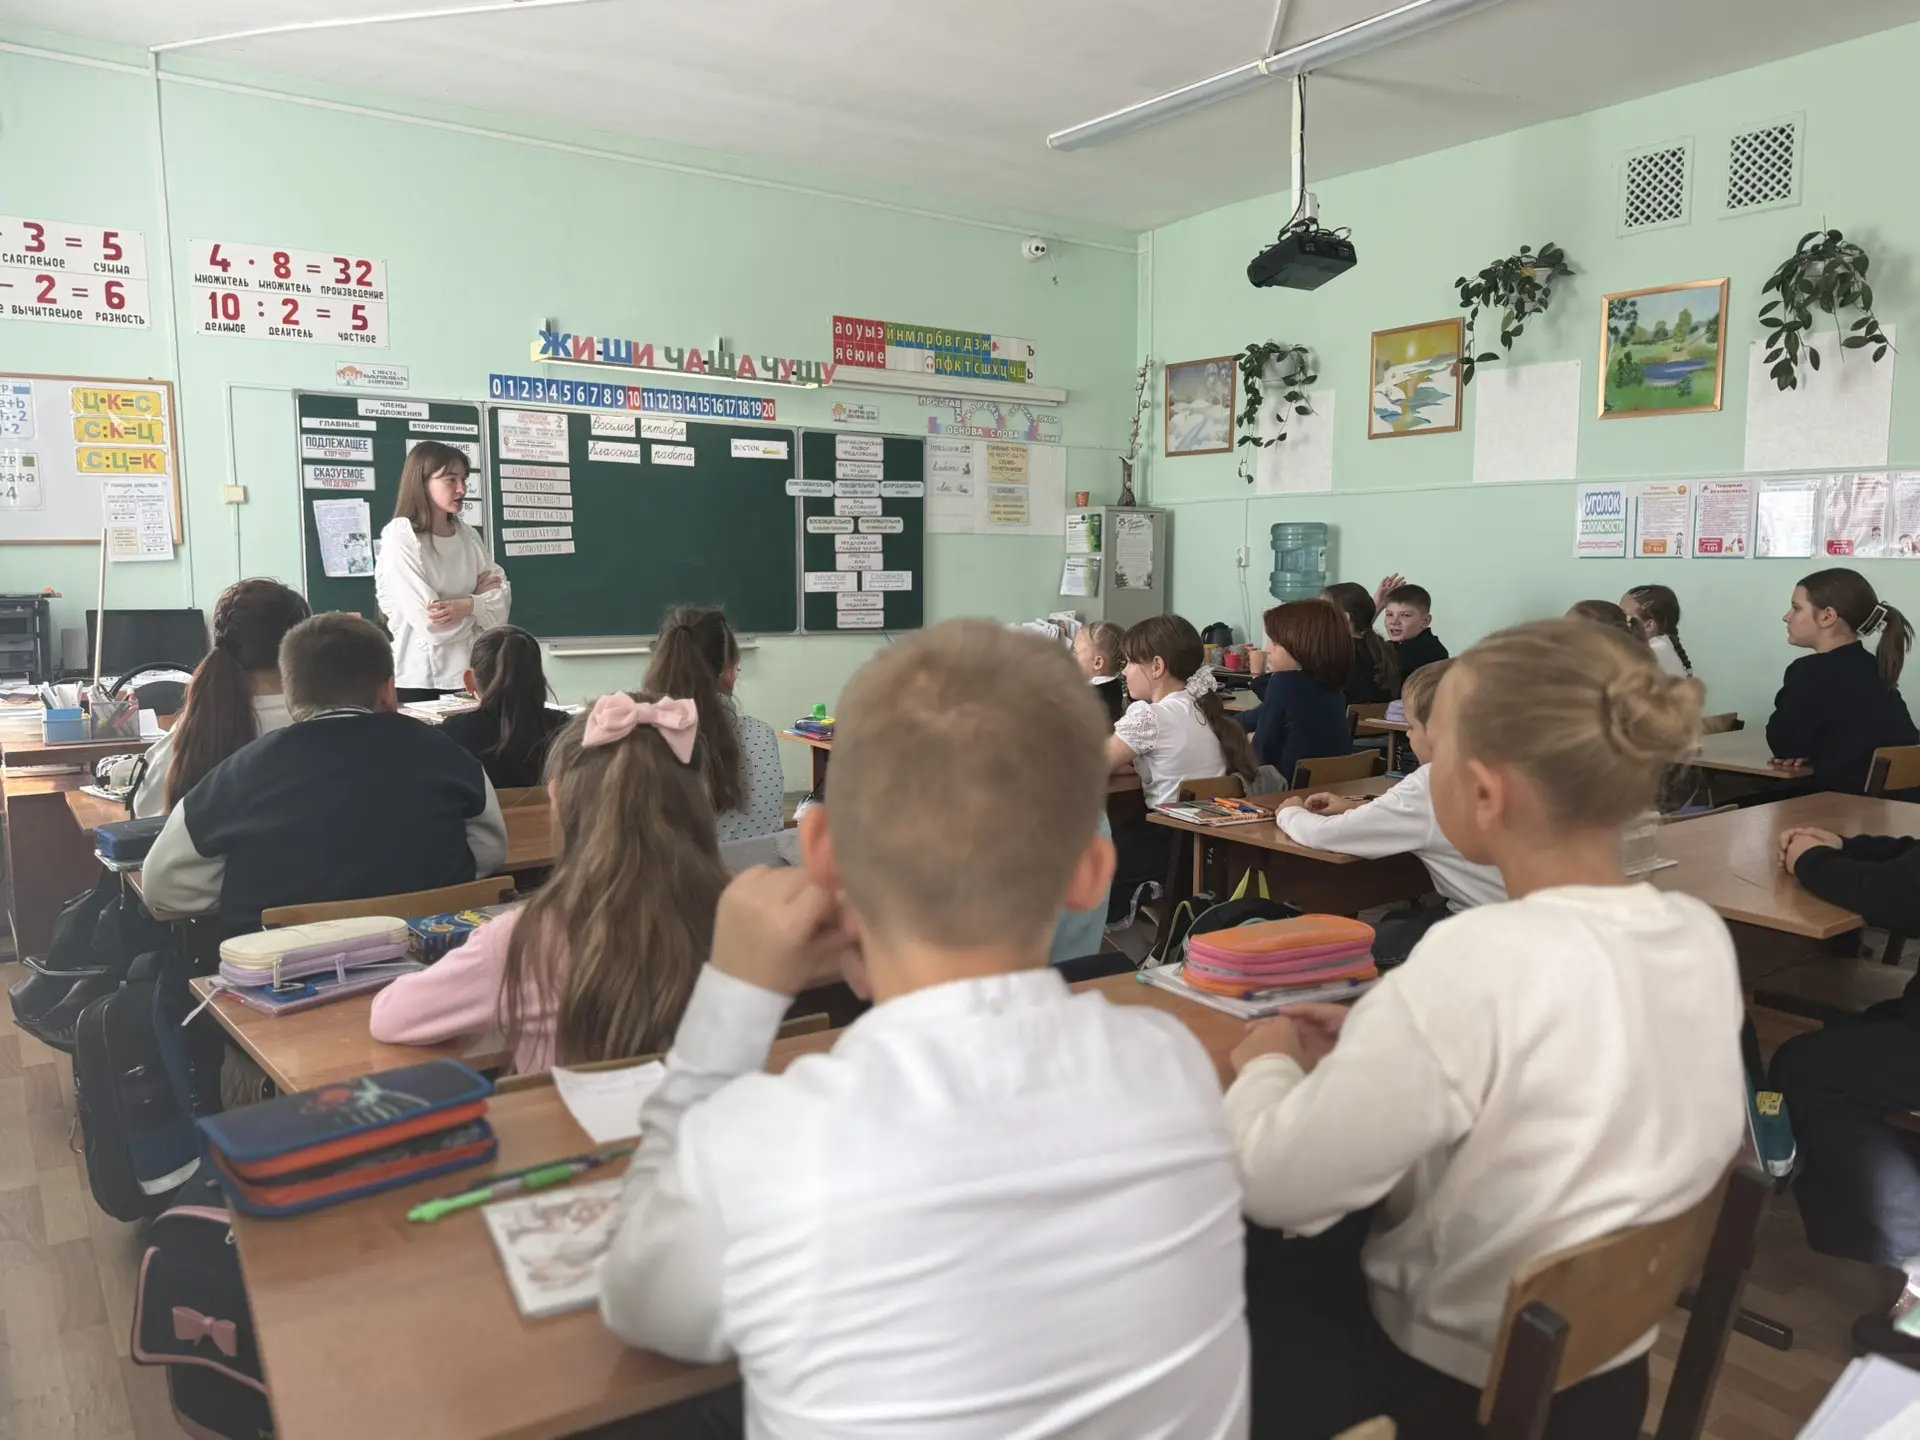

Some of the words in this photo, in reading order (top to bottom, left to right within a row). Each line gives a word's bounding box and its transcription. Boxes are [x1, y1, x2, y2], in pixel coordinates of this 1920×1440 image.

[23, 222, 46, 253] 3
[103, 231, 123, 261] 5
[209, 244, 231, 272] 4
[273, 251, 292, 279] 8
[333, 257, 373, 287] 32
[35, 274, 57, 304] 2
[105, 280, 125, 310] 6
[208, 291, 240, 321] 10
[281, 298, 300, 326] 2
[351, 304, 368, 331] 5
[493, 378, 501, 396] 0
[507, 380, 514, 396] 1
[521, 381, 530, 397] 2
[535, 382, 543, 399] 3
[549, 384, 558, 400] 4
[563, 385, 571, 401] 5
[577, 386, 585, 402] 6
[590, 387, 598, 403] 7
[604, 388, 611, 404] 8
[616, 390, 624, 405] 9
[628, 390, 640, 407] 10
[643, 391, 654, 408] 11
[657, 392, 669, 409] 12
[671, 393, 682, 410] 13
[685, 395, 696, 412] 14
[699, 396, 709, 412] 15
[712, 397, 723, 414] 16
[725, 398, 735, 414] 17
[738, 399, 749, 415] 18
[751, 400, 761, 416] 19
[763, 400, 774, 417] 20
[365, 408, 422, 418] ПРЕДЛОЖЕНИЯ
[319, 420, 361, 428] ГЛАВНЫЕ
[412, 424, 475, 432] ВТОРОСТЕПЕННЫЕ
[947, 426, 983, 436] ОСНОВА
[990, 429, 1019, 439] СЛОВА
[306, 436, 368, 450] ПОДЛЕЖАЩЕЕ
[314, 467, 364, 479] СКАЗУЕМОЕ
[1585, 491, 1620, 516] УГОЛОК
[1580, 518, 1624, 534] БЕЗОПАСНОСТИ
